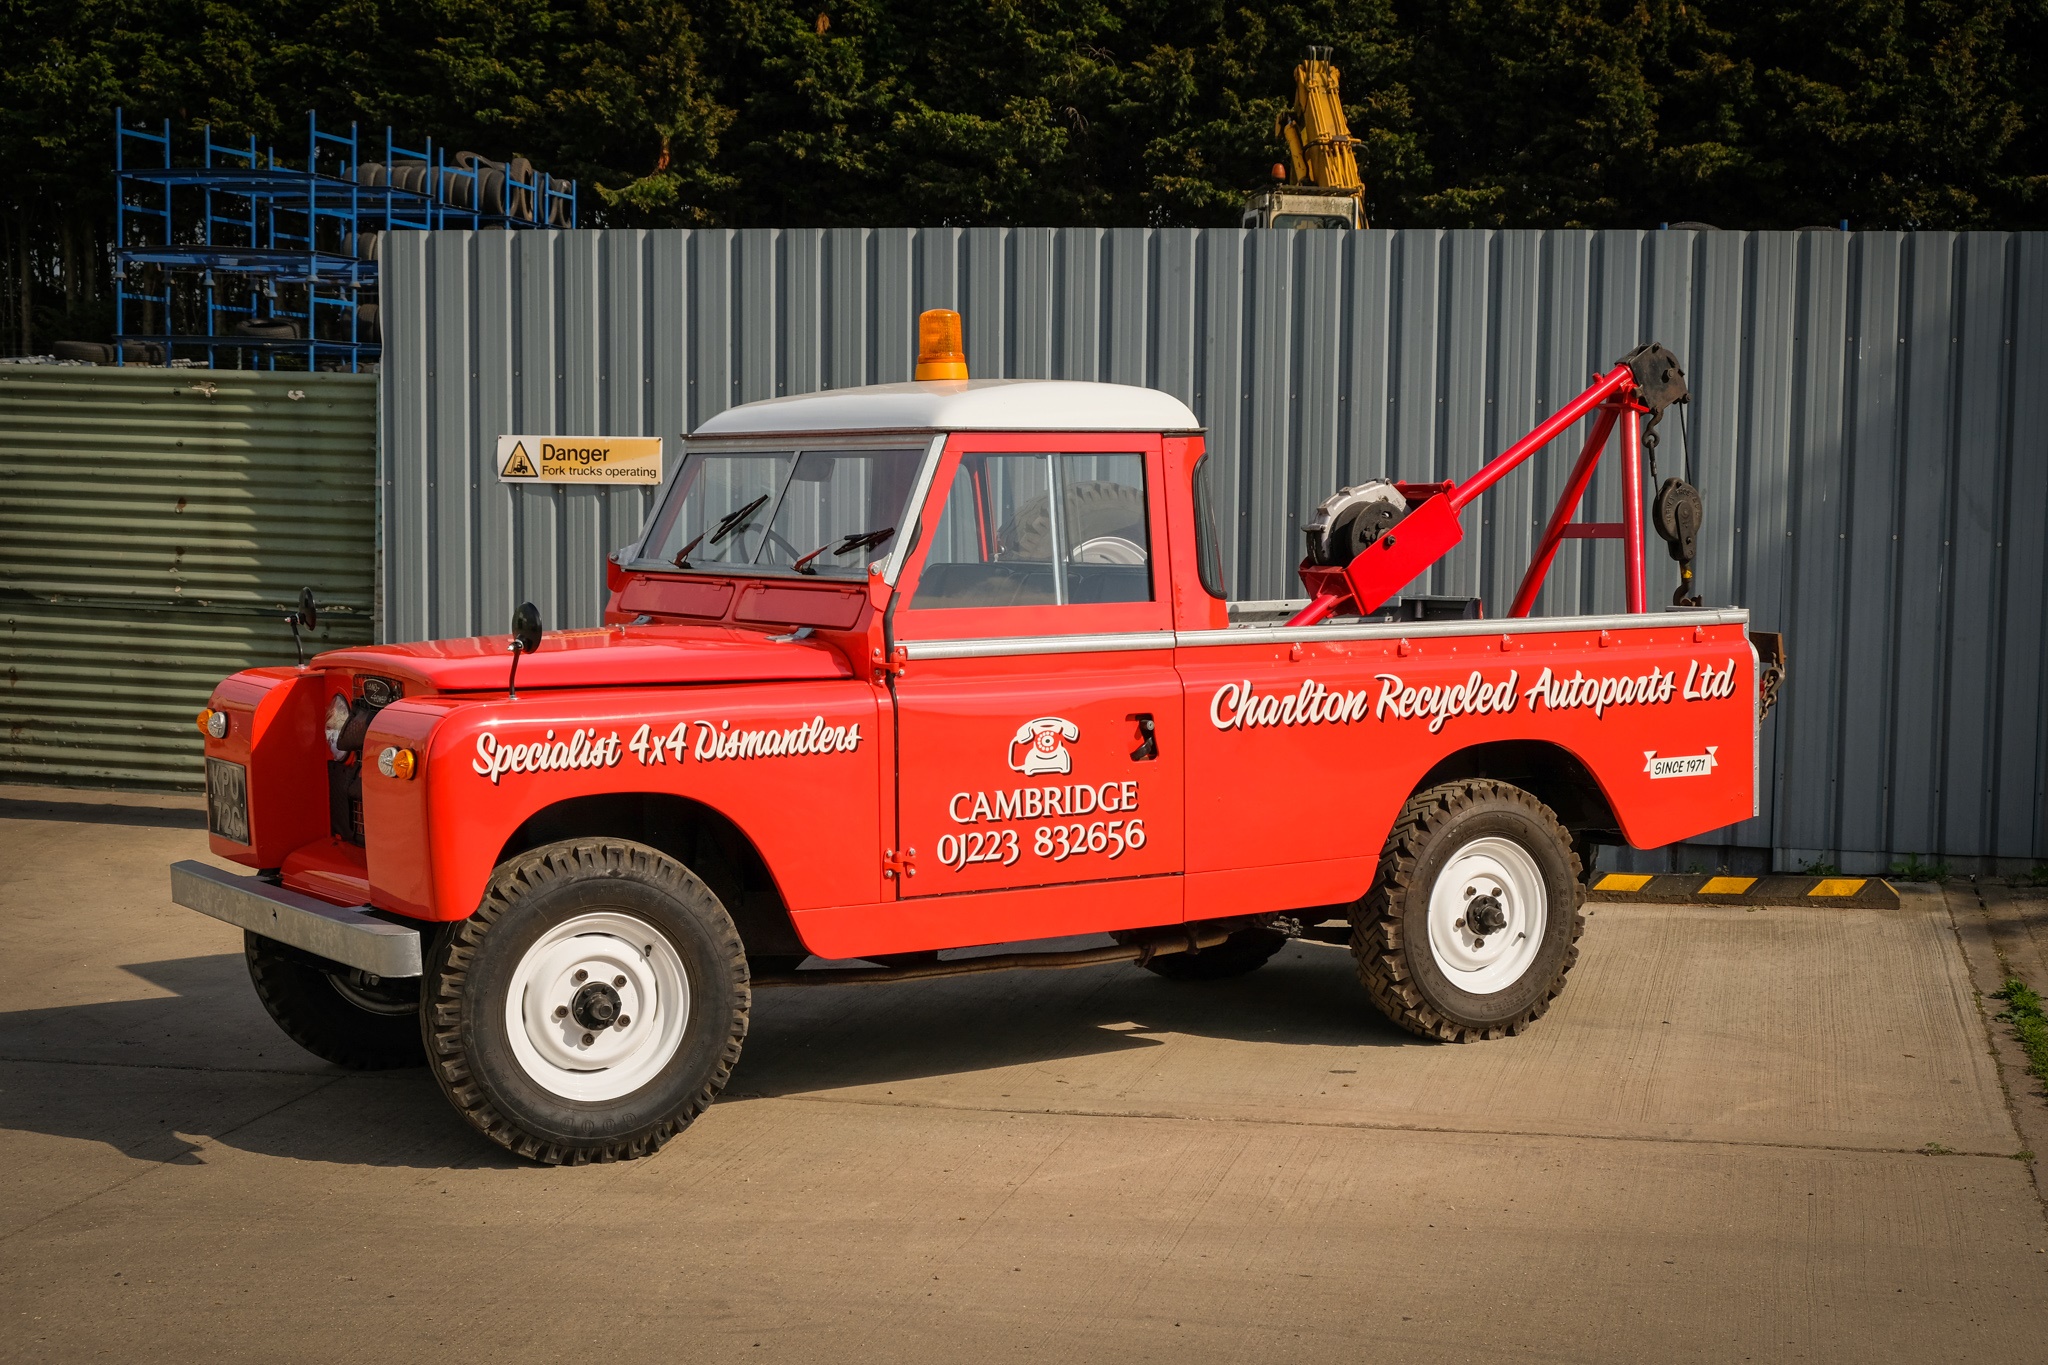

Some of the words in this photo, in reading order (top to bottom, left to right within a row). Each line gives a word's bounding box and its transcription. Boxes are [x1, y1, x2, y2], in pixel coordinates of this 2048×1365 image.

[542, 443, 610, 465] Danger
[542, 465, 566, 476] Fork
[569, 465, 603, 477] trucks
[605, 466, 657, 479] operating
[1211, 679, 1367, 728] Charlton
[1375, 670, 1517, 732] Recycled
[1524, 666, 1676, 716] Autoparts
[1683, 659, 1734, 699] Ltd
[473, 725, 620, 782] Specialist
[629, 722, 686, 764] 4x4
[694, 716, 861, 760] Dismantlers
[1654, 760, 1685, 775] SINCE
[1686, 758, 1706, 773] 1971
[212, 763, 239, 801] KPU
[949, 781, 1138, 824] CAMBRIDGE
[937, 830, 1018, 870] 01223
[1034, 819, 1144, 860] 832656
